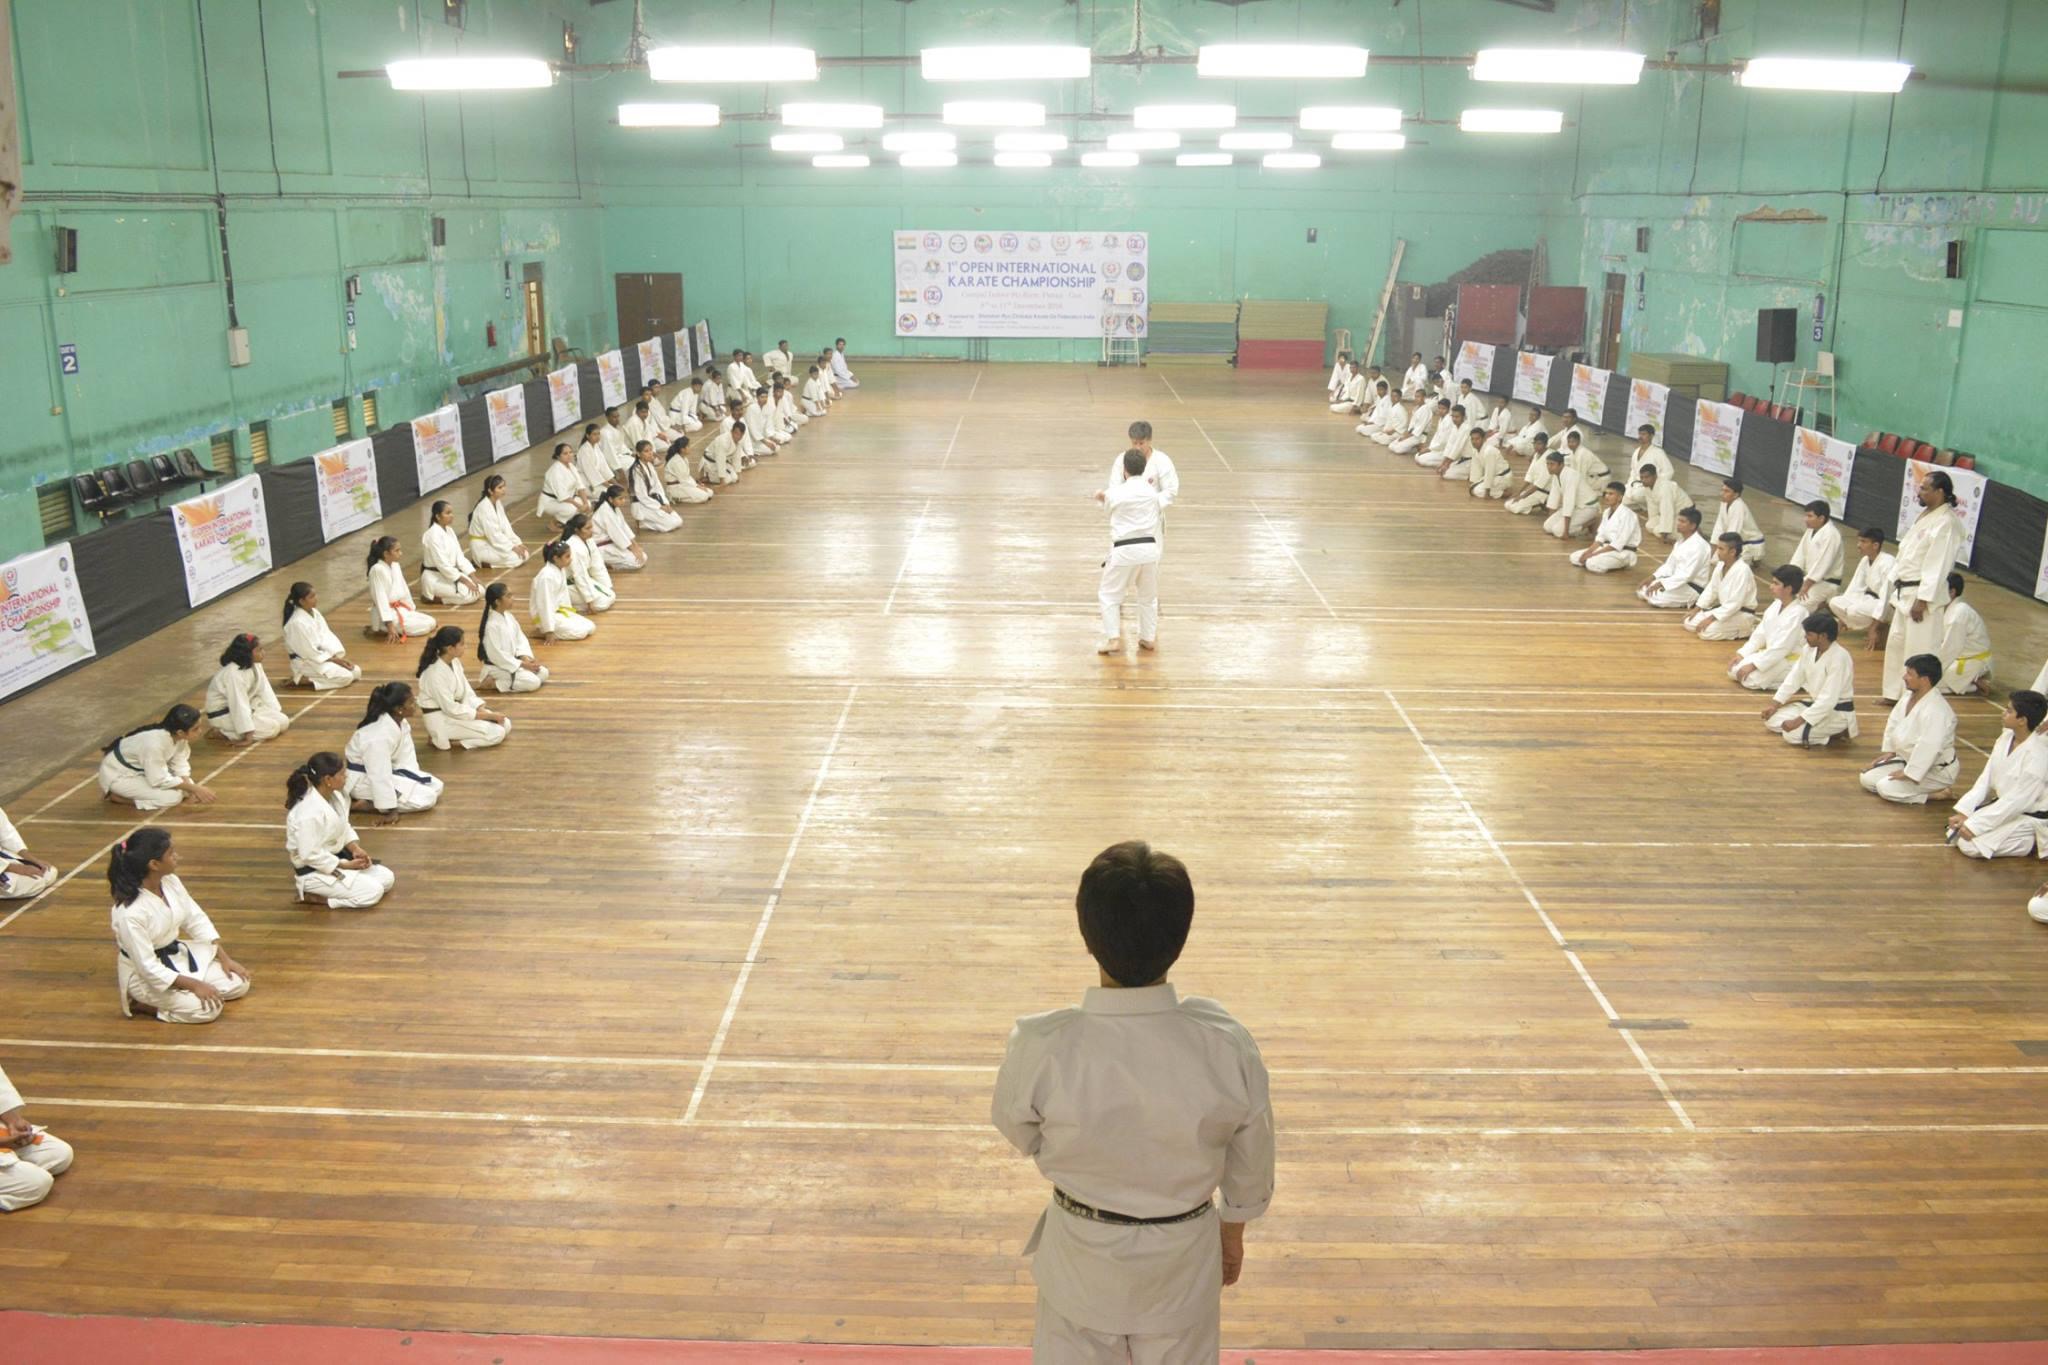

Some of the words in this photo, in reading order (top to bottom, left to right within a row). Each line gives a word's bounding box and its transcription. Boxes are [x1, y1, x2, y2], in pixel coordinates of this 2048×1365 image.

[959, 262, 993, 273] OPEN
[997, 262, 1097, 274] INTERNATIONAL
[948, 276, 998, 287] KARATE
[1001, 276, 1097, 288] CHAMPIONSHIP
[347, 312, 354, 324] 3
[1814, 328, 1822, 340] 3
[63, 355, 77, 372] 2
